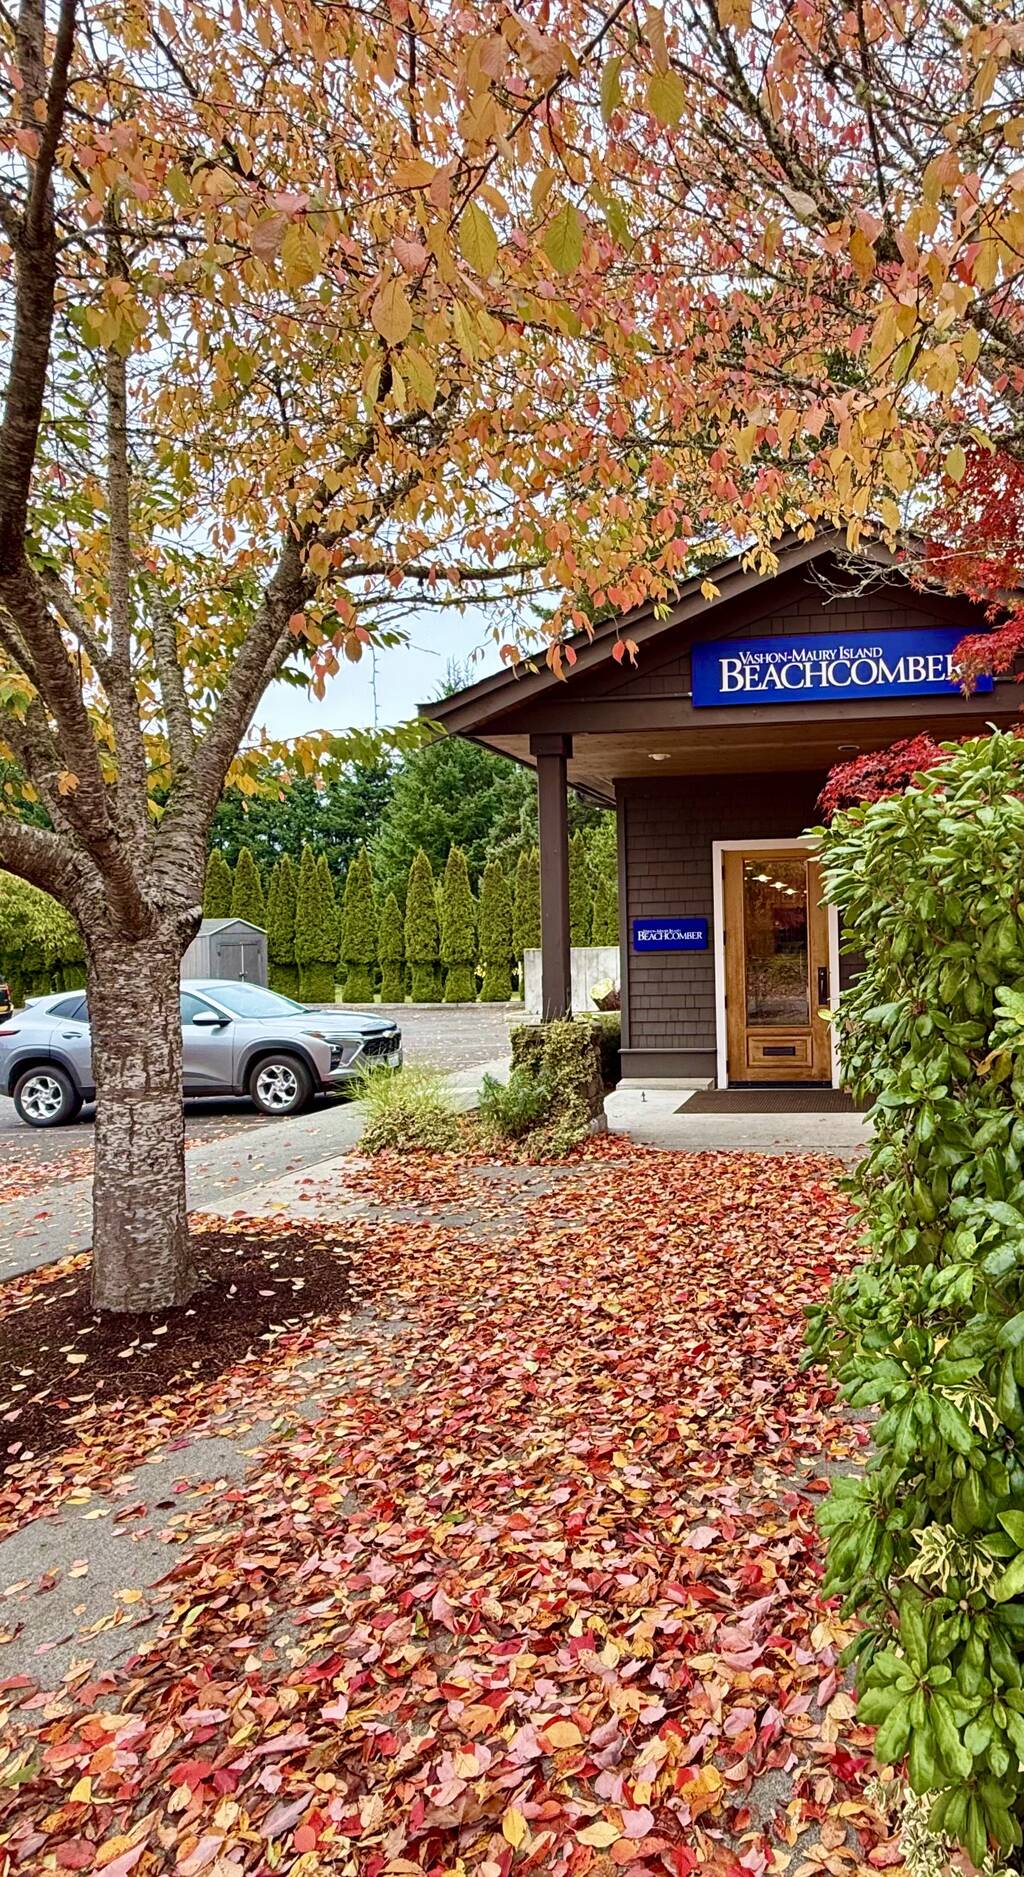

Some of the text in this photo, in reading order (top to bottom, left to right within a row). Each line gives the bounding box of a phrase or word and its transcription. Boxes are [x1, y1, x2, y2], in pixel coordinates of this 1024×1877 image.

[738, 646, 883, 665] VASHON-MAURY ISLAND
[638, 931, 703, 941] BEACHCOMBER
